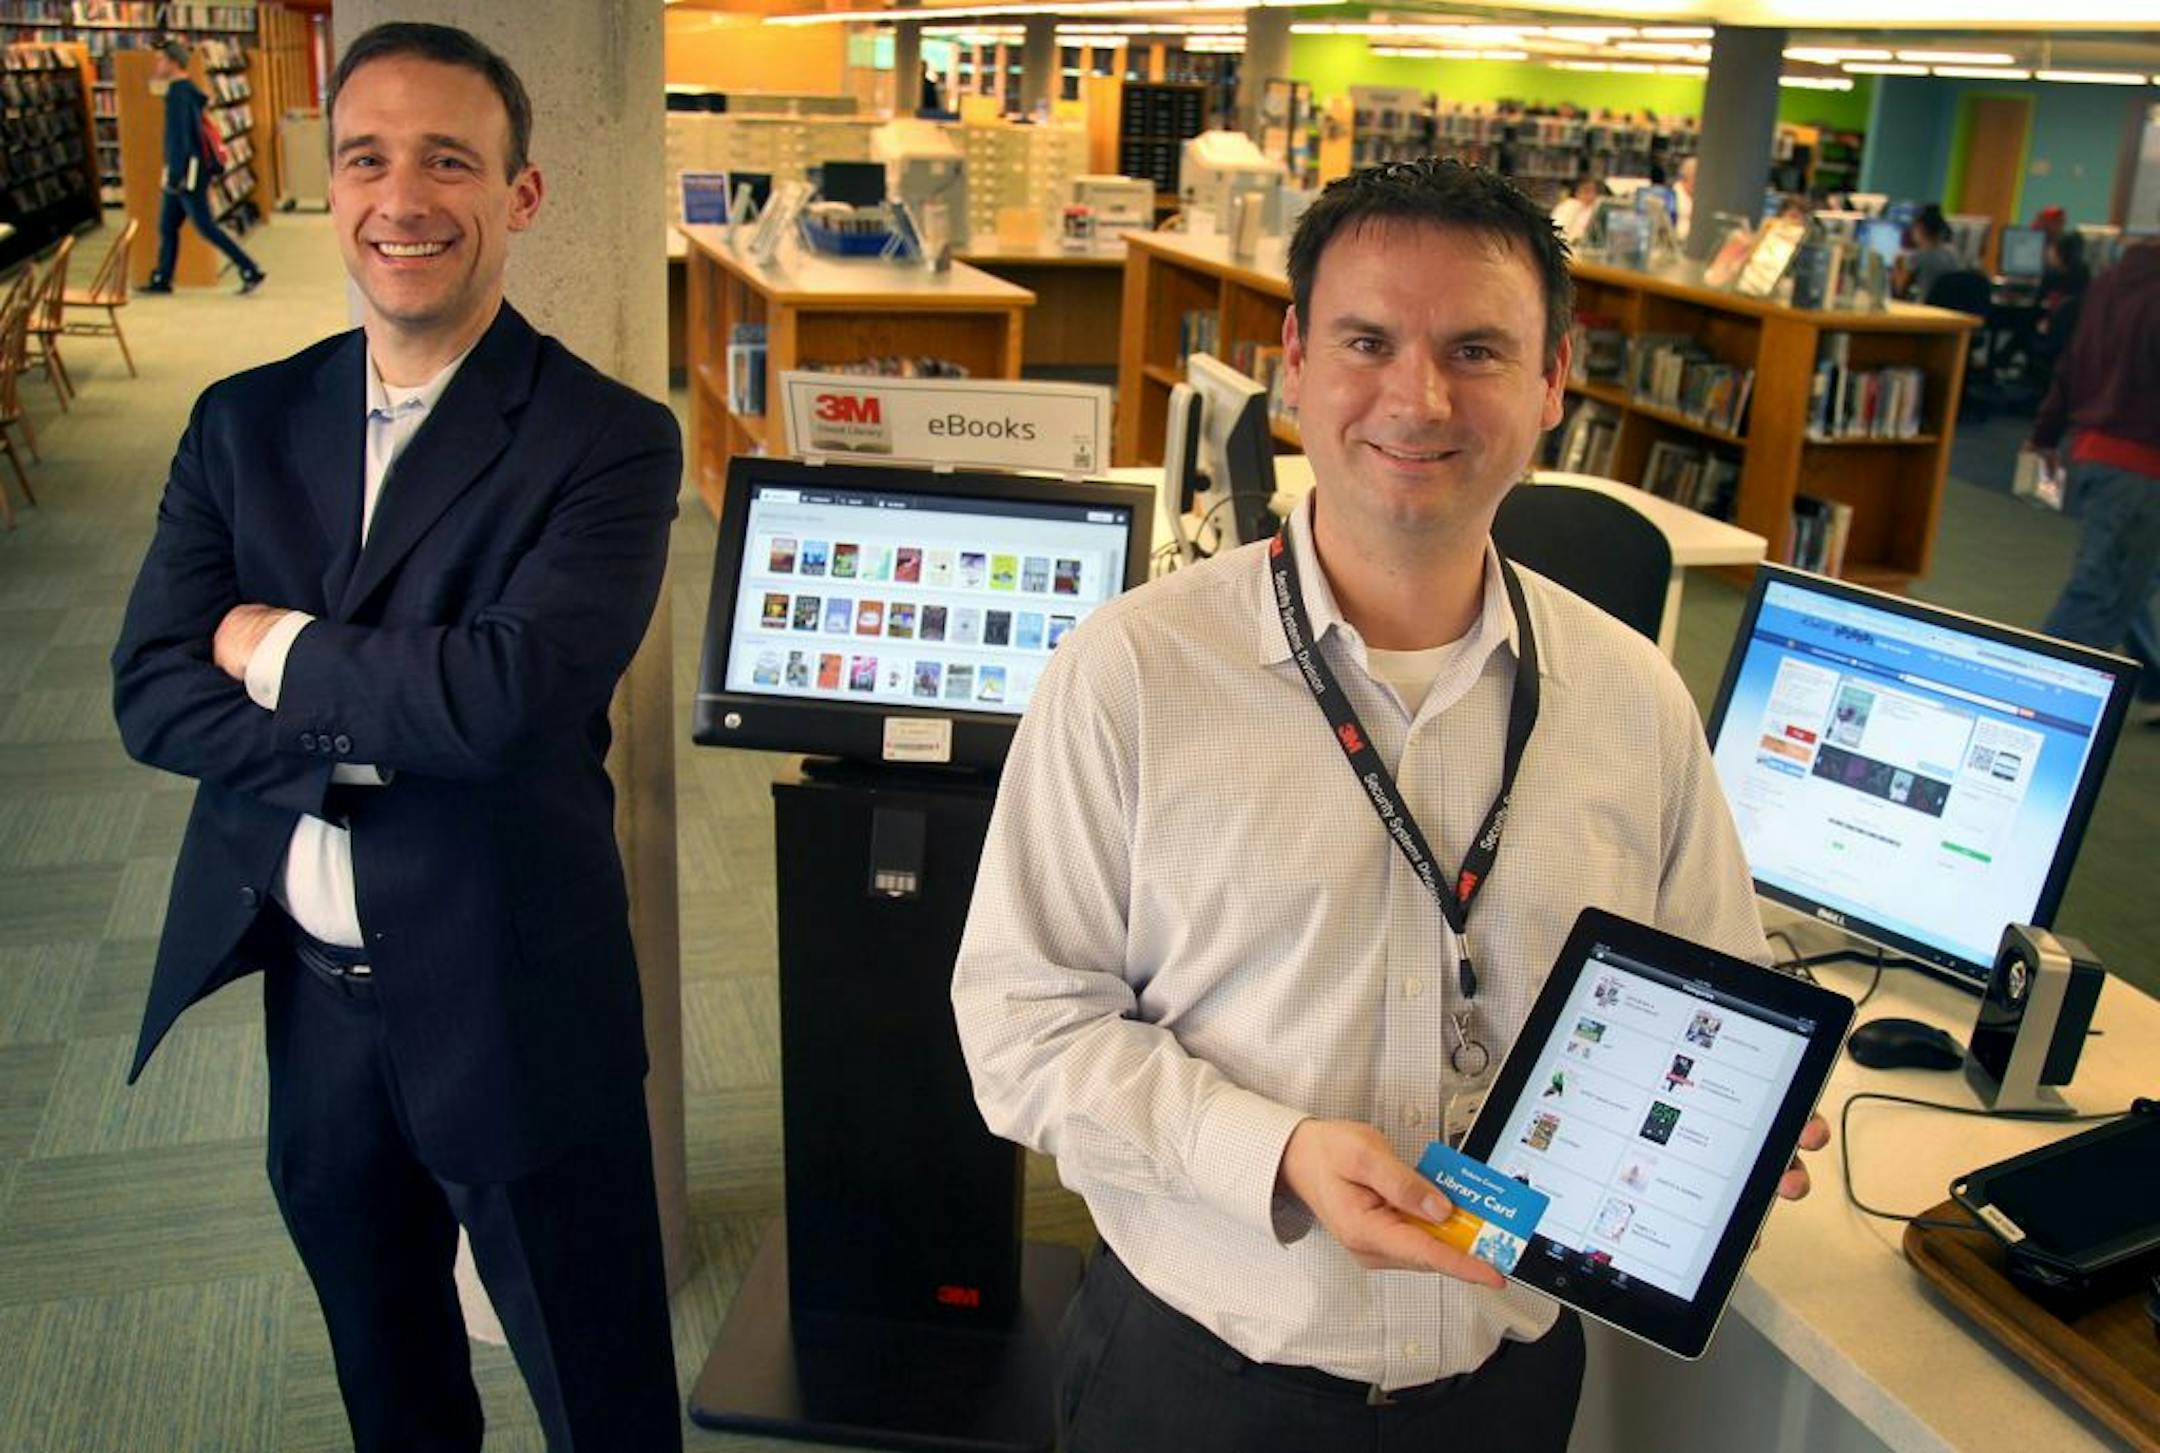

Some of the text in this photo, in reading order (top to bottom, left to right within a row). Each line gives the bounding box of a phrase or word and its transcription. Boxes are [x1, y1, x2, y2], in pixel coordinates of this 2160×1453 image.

[815, 394, 880, 424] 3M
[928, 414, 1036, 440] eBooks
[1297, 650, 1326, 695] Division
[1338, 722, 1365, 754] 3M
[1363, 772, 1395, 818] Security
[1389, 818, 1423, 861] Systems
[1817, 907, 1846, 927] DELL
[1435, 1171, 1517, 1219] Library Card
[936, 1285, 980, 1309] 3M
